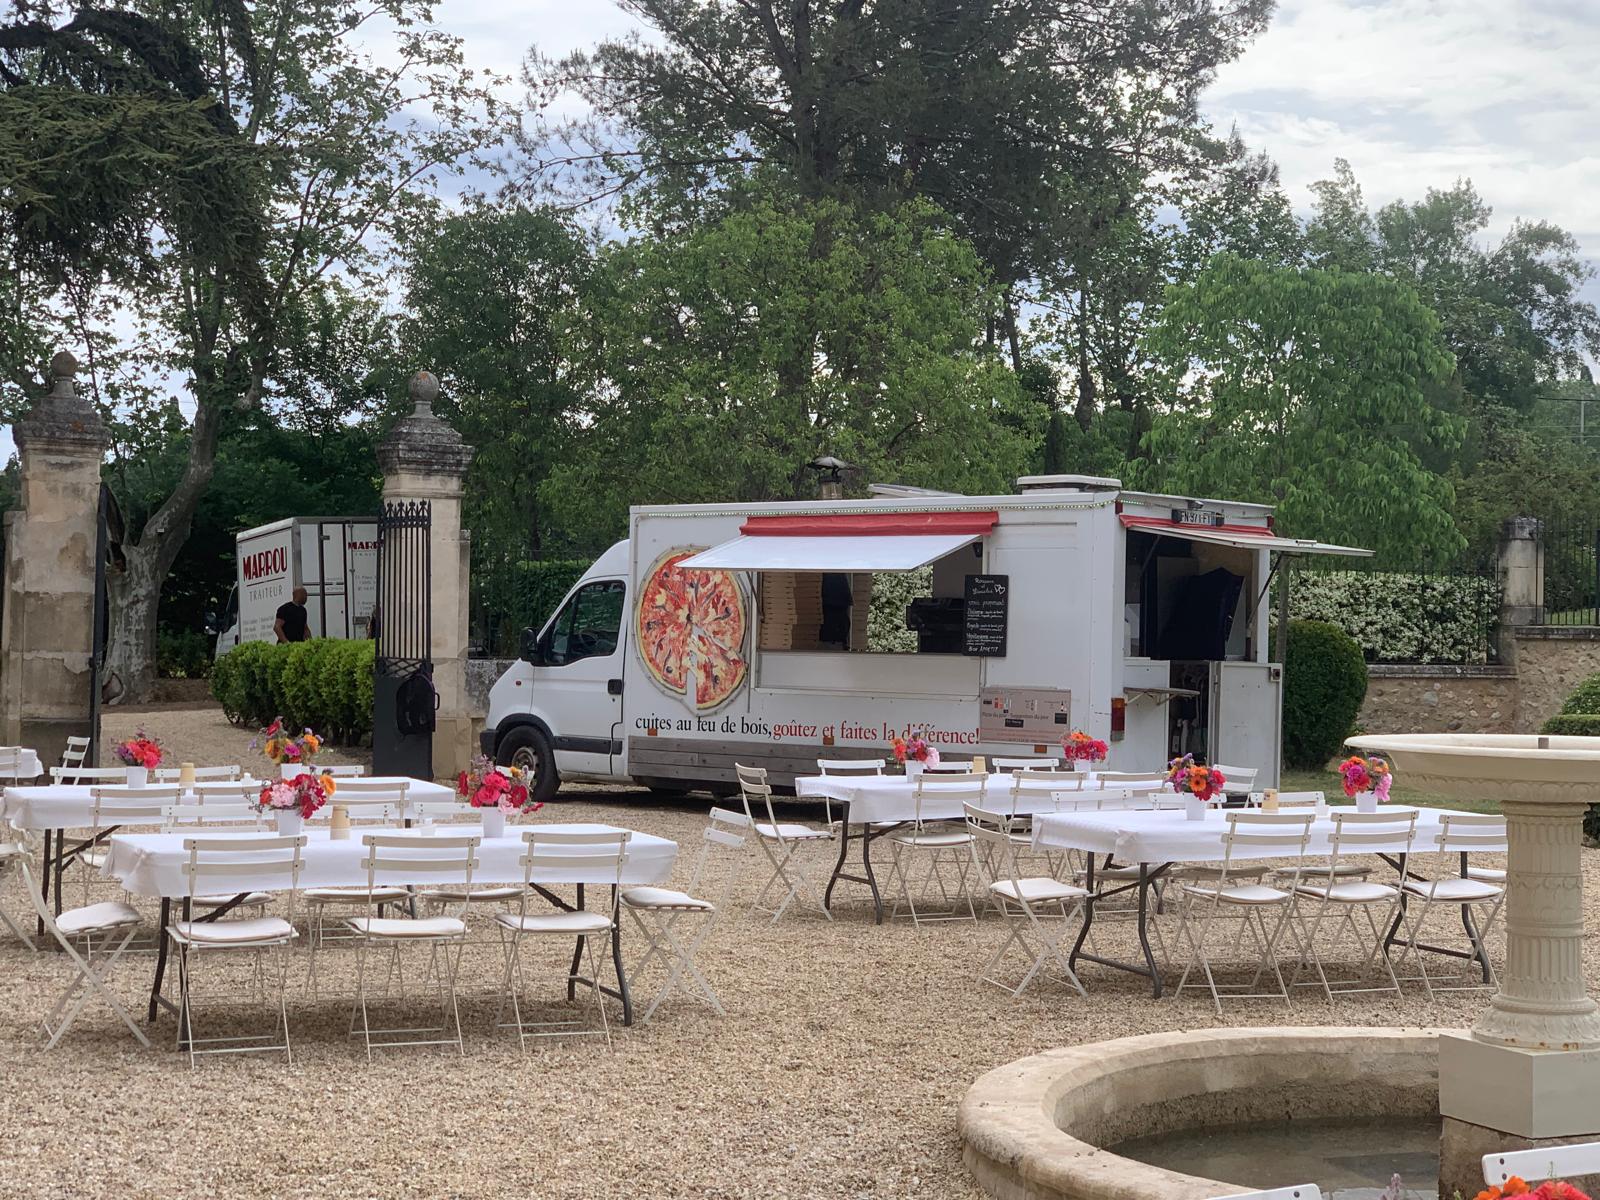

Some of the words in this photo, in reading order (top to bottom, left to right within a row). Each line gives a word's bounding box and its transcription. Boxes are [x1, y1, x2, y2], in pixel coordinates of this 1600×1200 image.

[243, 545, 288, 582] MARROU
[249, 584, 283, 602] TRAITEUR
[635, 712, 672, 731] cuites
[676, 718, 692, 732] au
[697, 715, 716, 733] feu
[720, 715, 737, 734] de
[741, 716, 772, 739] bois,
[772, 719, 818, 741] goûtez
[822, 722, 836, 738] et
[839, 720, 878, 741] faites
[883, 722, 895, 741] la
[901, 723, 981, 745] dfférence!
